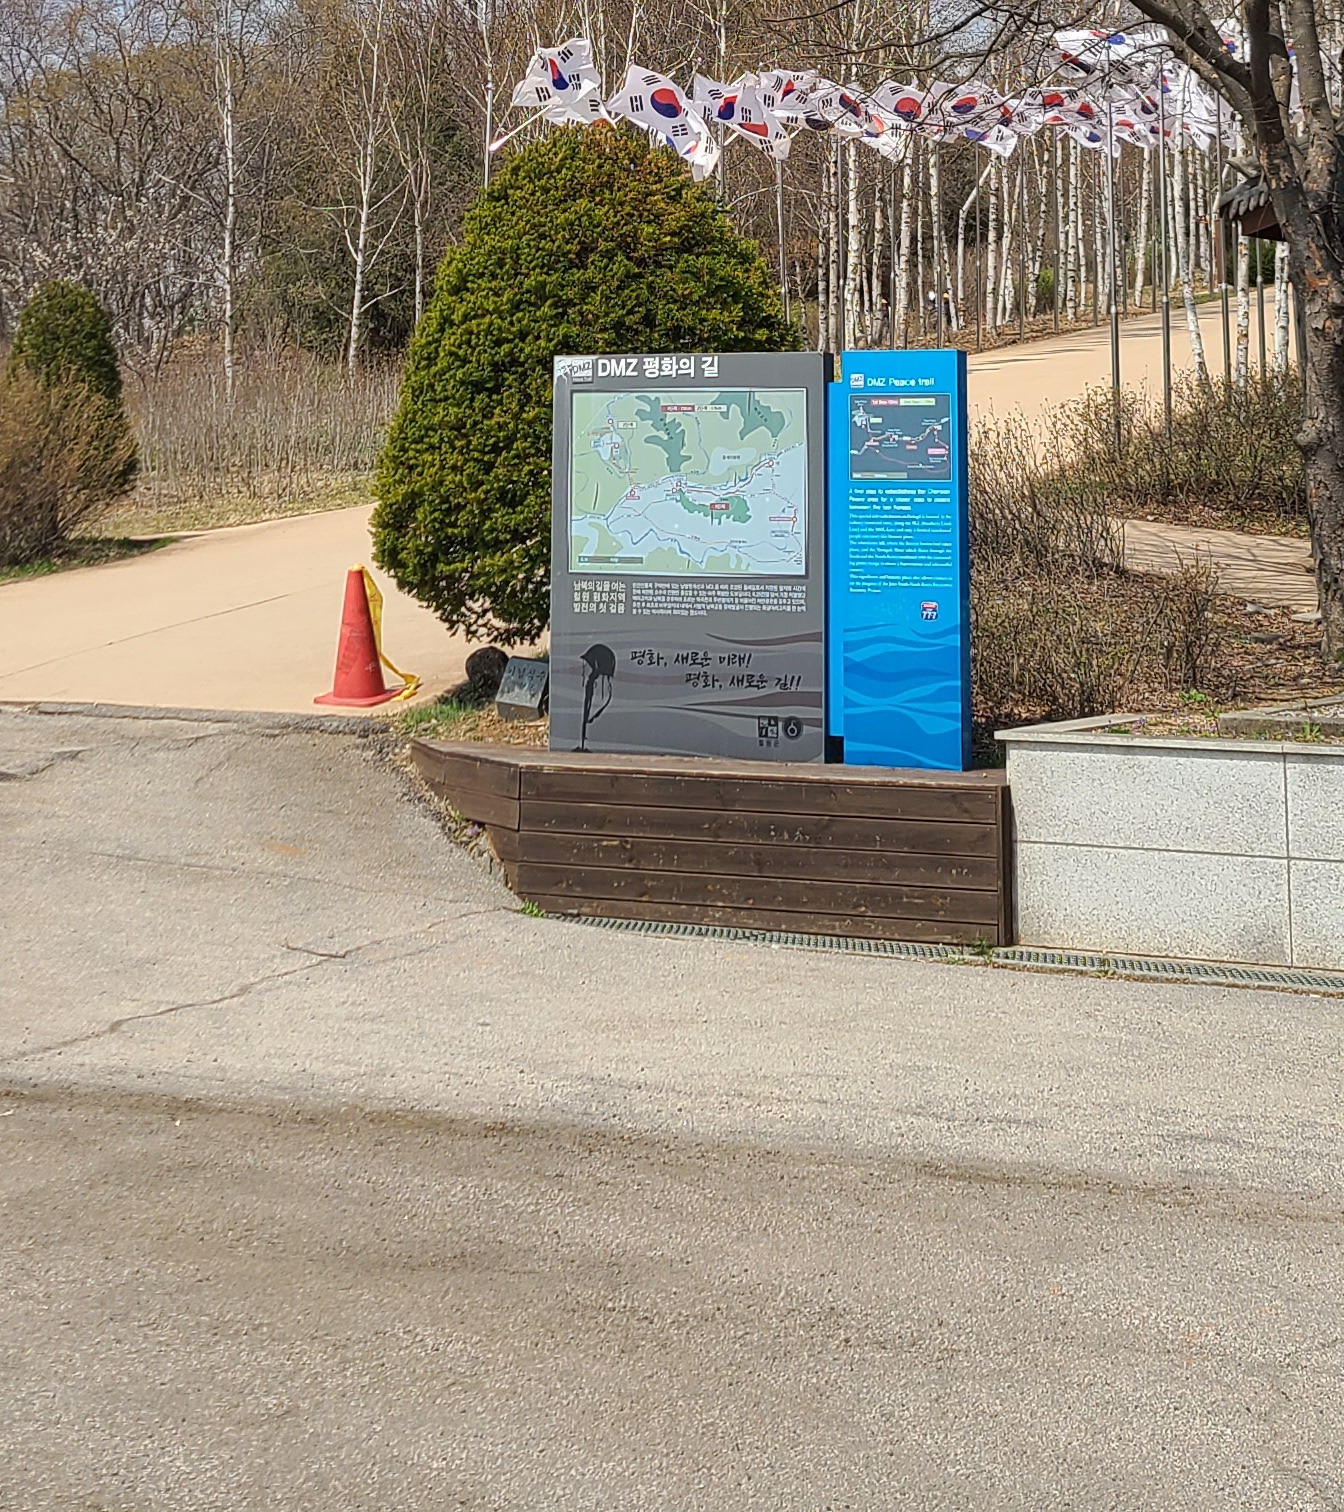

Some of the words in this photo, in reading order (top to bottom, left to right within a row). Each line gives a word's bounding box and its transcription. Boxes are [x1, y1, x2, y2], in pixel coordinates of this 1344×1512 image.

[598, 359, 638, 377] DMZ
[643, 356, 695, 378] 평화의
[701, 356, 719, 377] 길
[867, 377, 886, 387] DMZ
[889, 377, 916, 387] Peace
[630, 649, 668, 667] 평화,
[674, 651, 712, 668] 새로운
[719, 652, 753, 668] 미래!
[685, 671, 723, 690] 평화,
[729, 673, 768, 690] 새로운
[775, 674, 802, 691] 길!!
